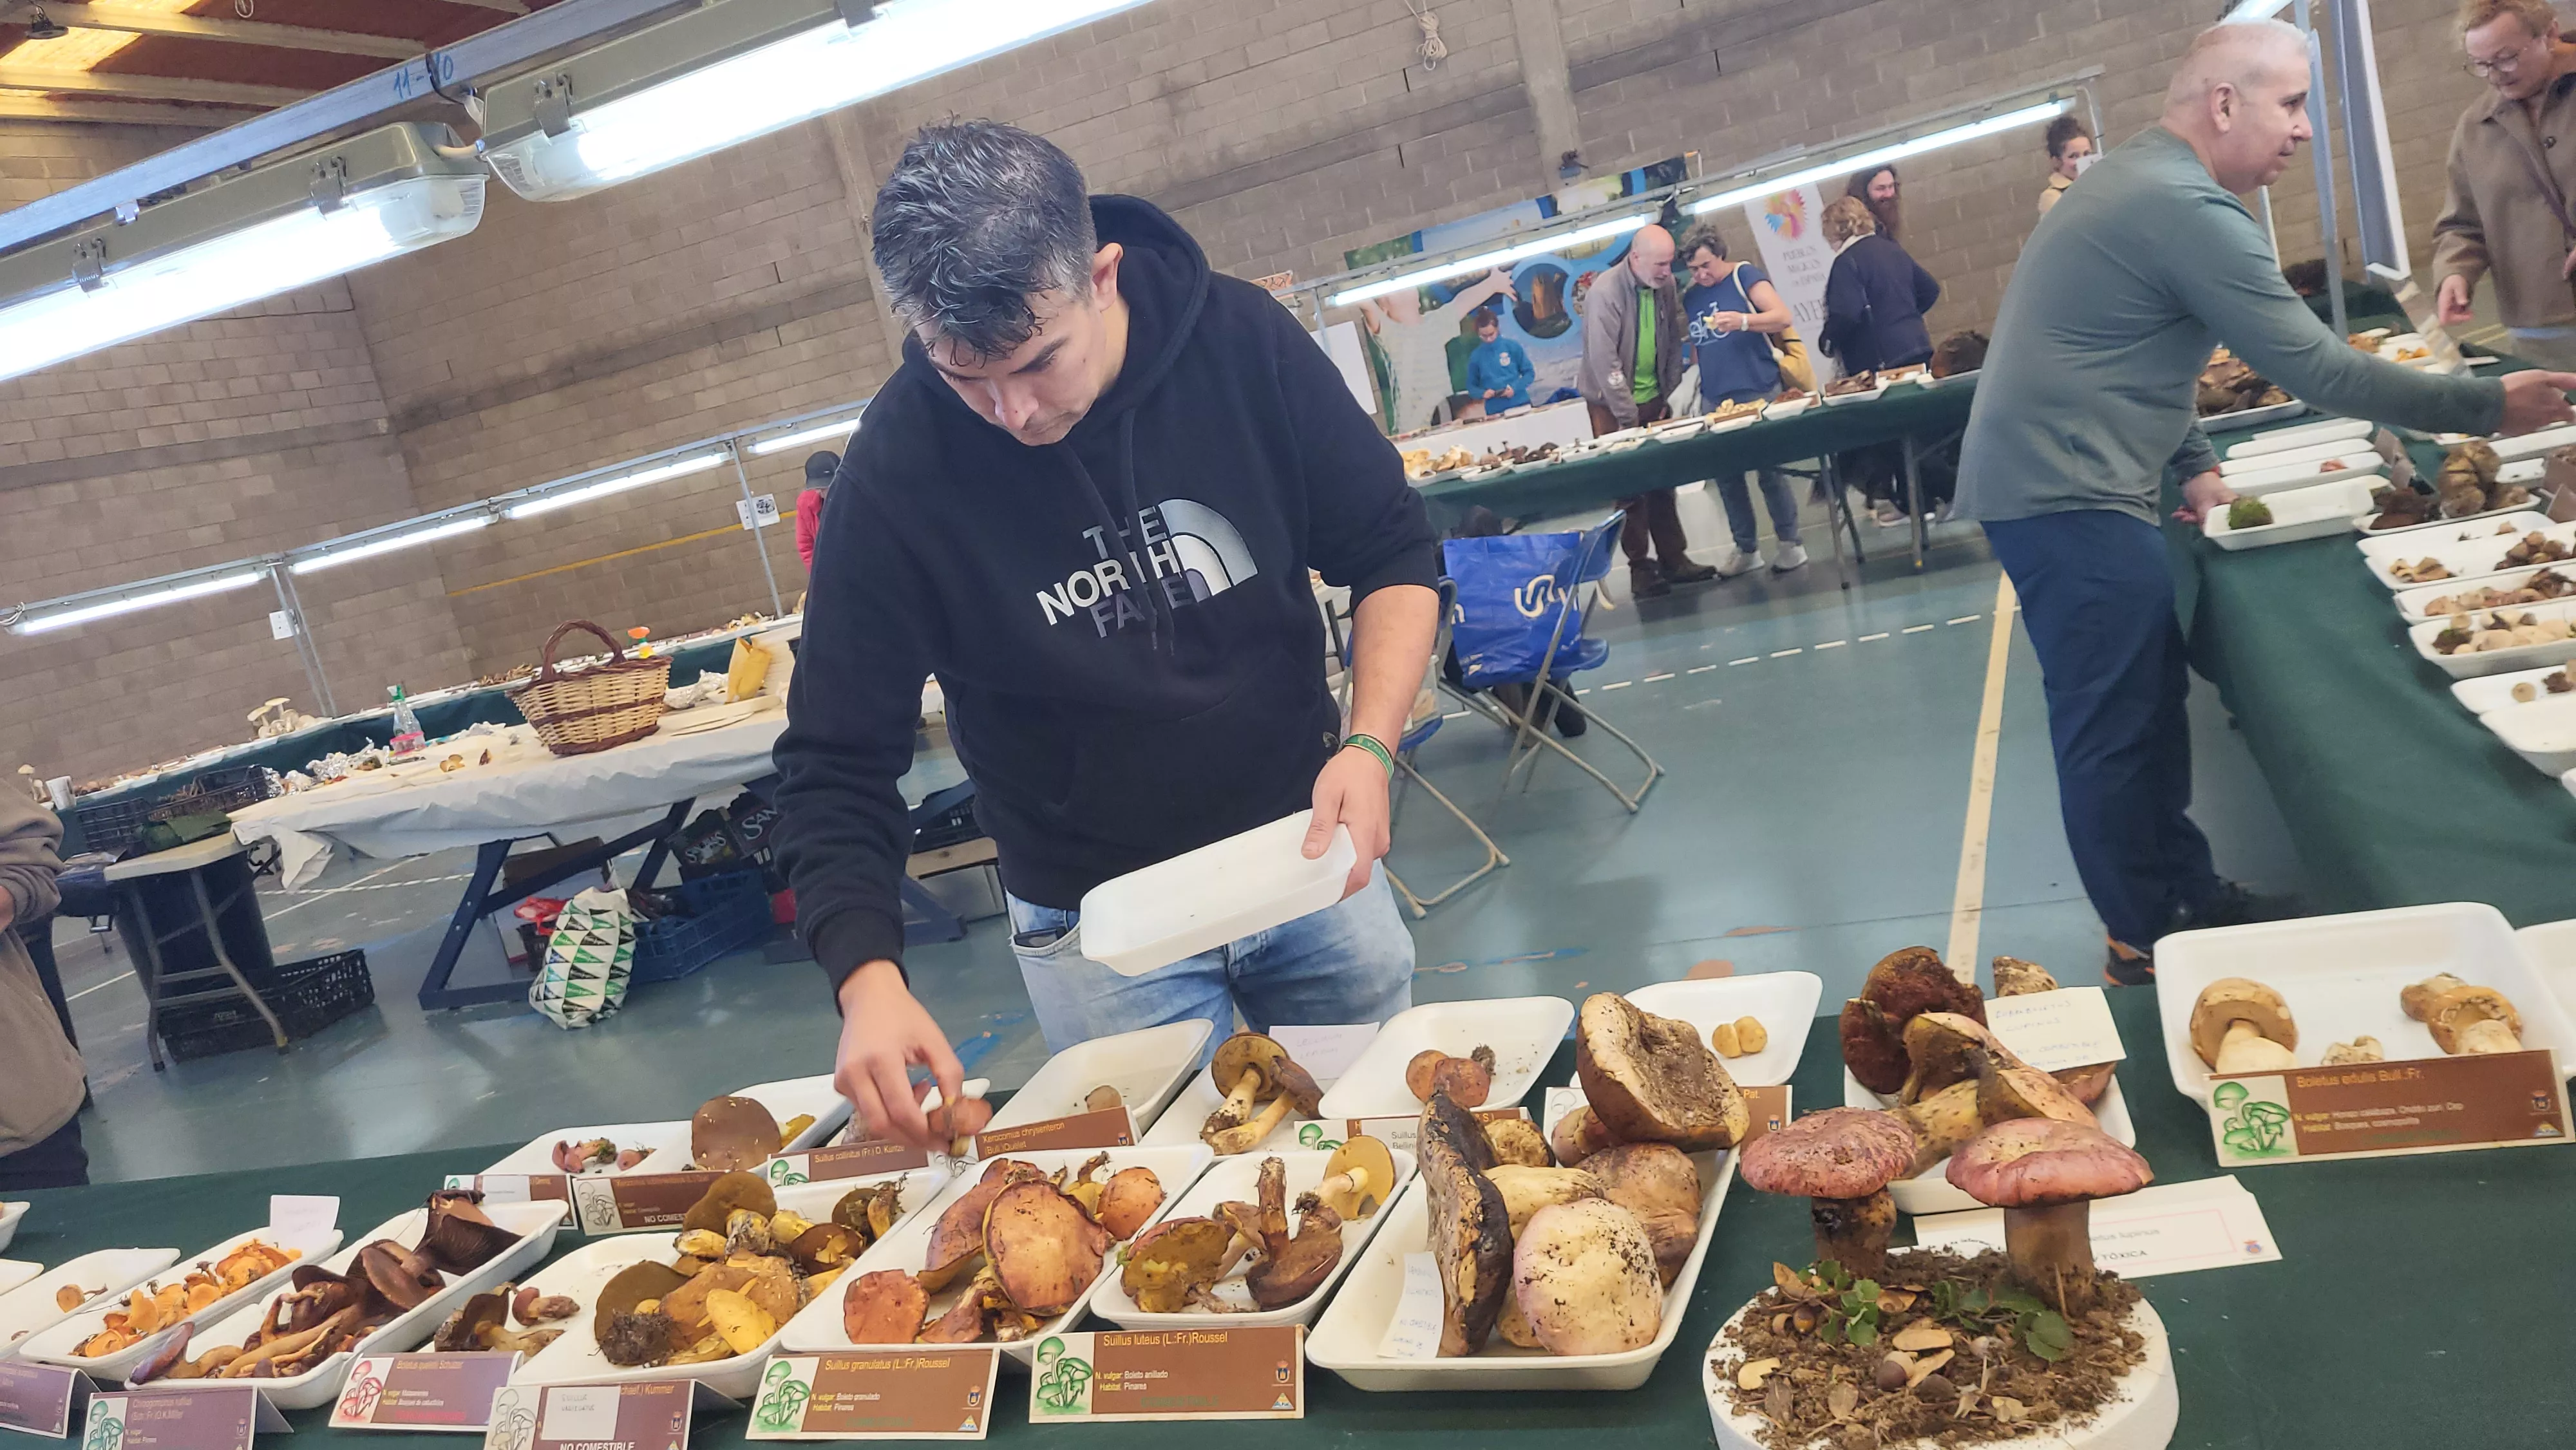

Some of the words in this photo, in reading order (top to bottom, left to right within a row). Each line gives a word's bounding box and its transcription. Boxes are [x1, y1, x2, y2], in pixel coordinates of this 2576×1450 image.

[1090, 576, 1193, 637] FAE
[982, 1131, 1020, 1144] Xerocomus
[815, 1154, 834, 1163] Suillus
[644, 1215, 656, 1223] NO
[657, 1213, 685, 1222] COMES
[1104, 1335, 1132, 1346] Suillus
[1134, 1334, 1160, 1345] luteus
[825, 1360, 849, 1370] Suillus
[851, 1359, 891, 1372] granulatus
[645, 1384, 675, 1395] Kummer
